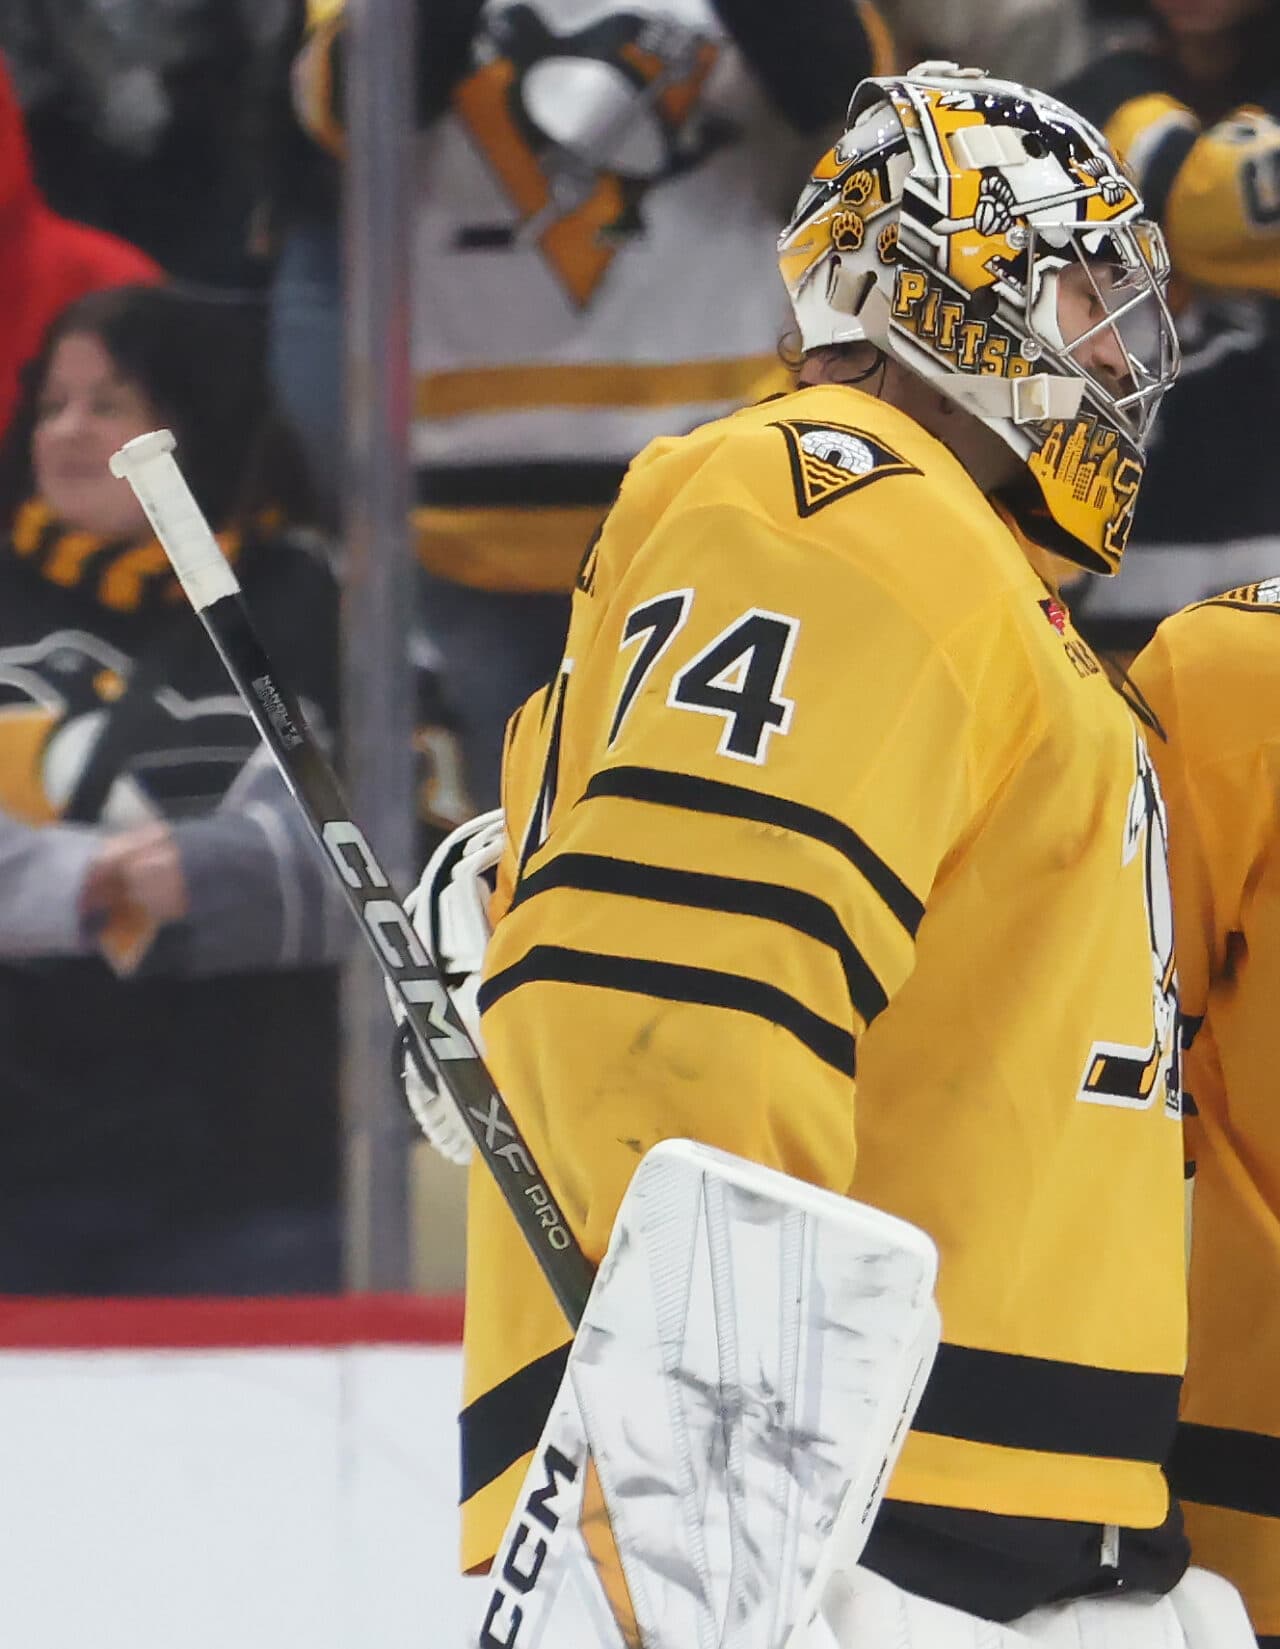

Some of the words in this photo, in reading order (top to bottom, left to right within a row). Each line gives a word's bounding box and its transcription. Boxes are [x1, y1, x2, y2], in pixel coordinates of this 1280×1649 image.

[608, 587, 801, 766] 74
[322, 821, 479, 1061] CCM
[468, 1094, 536, 1176] XF
[524, 1183, 571, 1250] PRO
[478, 1443, 579, 1649] CCM
